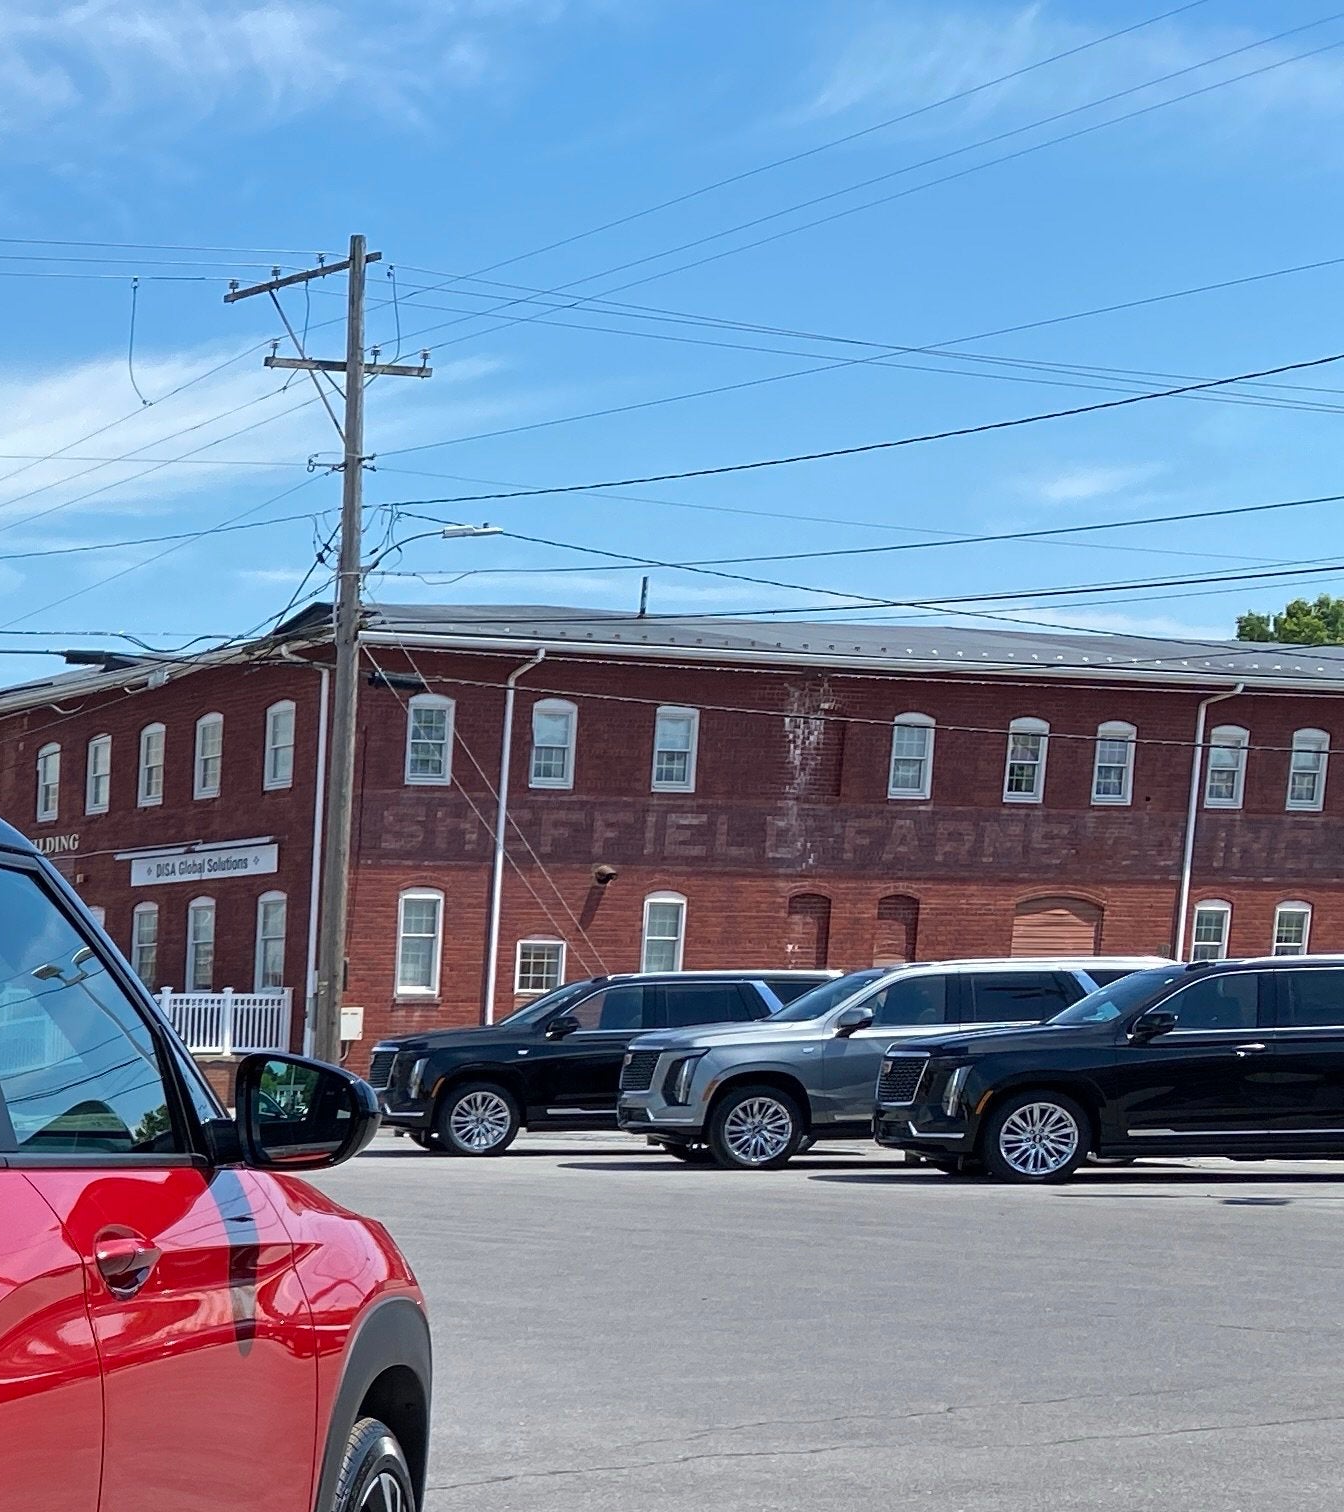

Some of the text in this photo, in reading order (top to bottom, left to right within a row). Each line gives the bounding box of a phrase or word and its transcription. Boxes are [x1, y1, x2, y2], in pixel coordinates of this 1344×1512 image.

[156, 856, 249, 878] DISA Global Solutions
